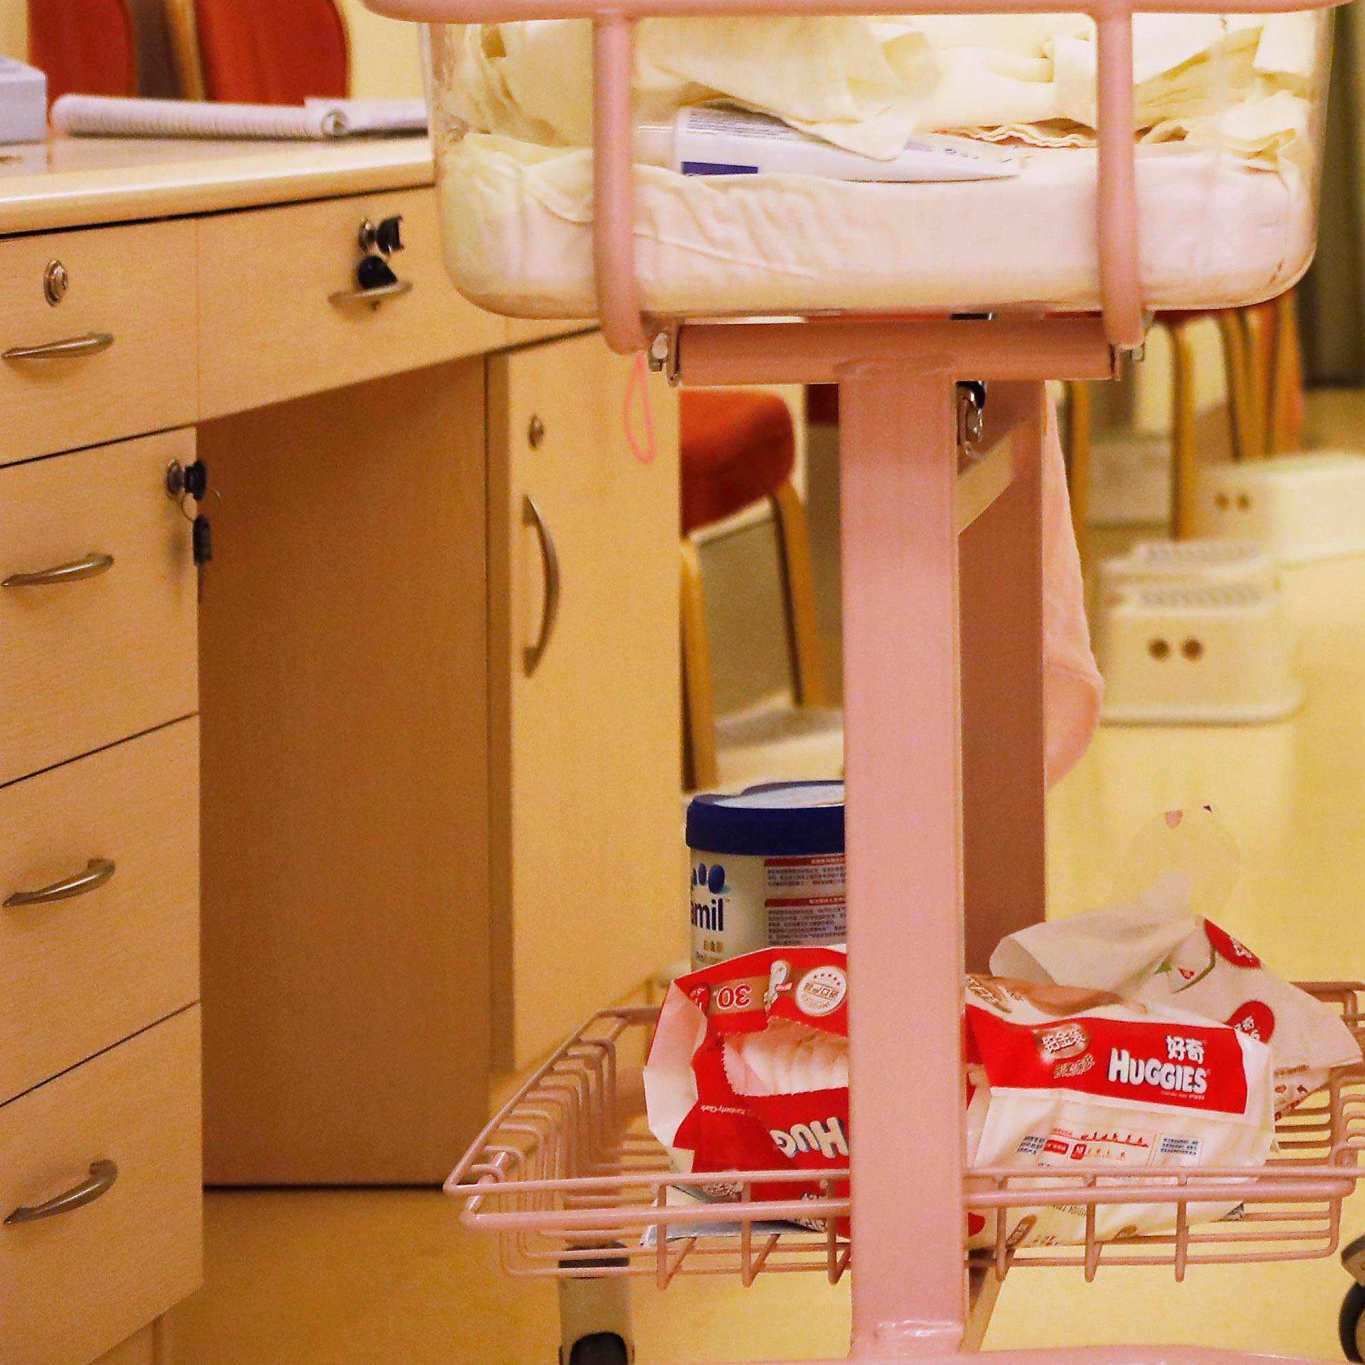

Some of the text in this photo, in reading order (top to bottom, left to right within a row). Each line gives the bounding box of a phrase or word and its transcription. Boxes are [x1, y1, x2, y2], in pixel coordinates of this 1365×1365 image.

[716, 983, 752, 1010] 30
[1165, 1034, 1206, 1064] 好奇
[1106, 1047, 1209, 1094] HUGGIES
